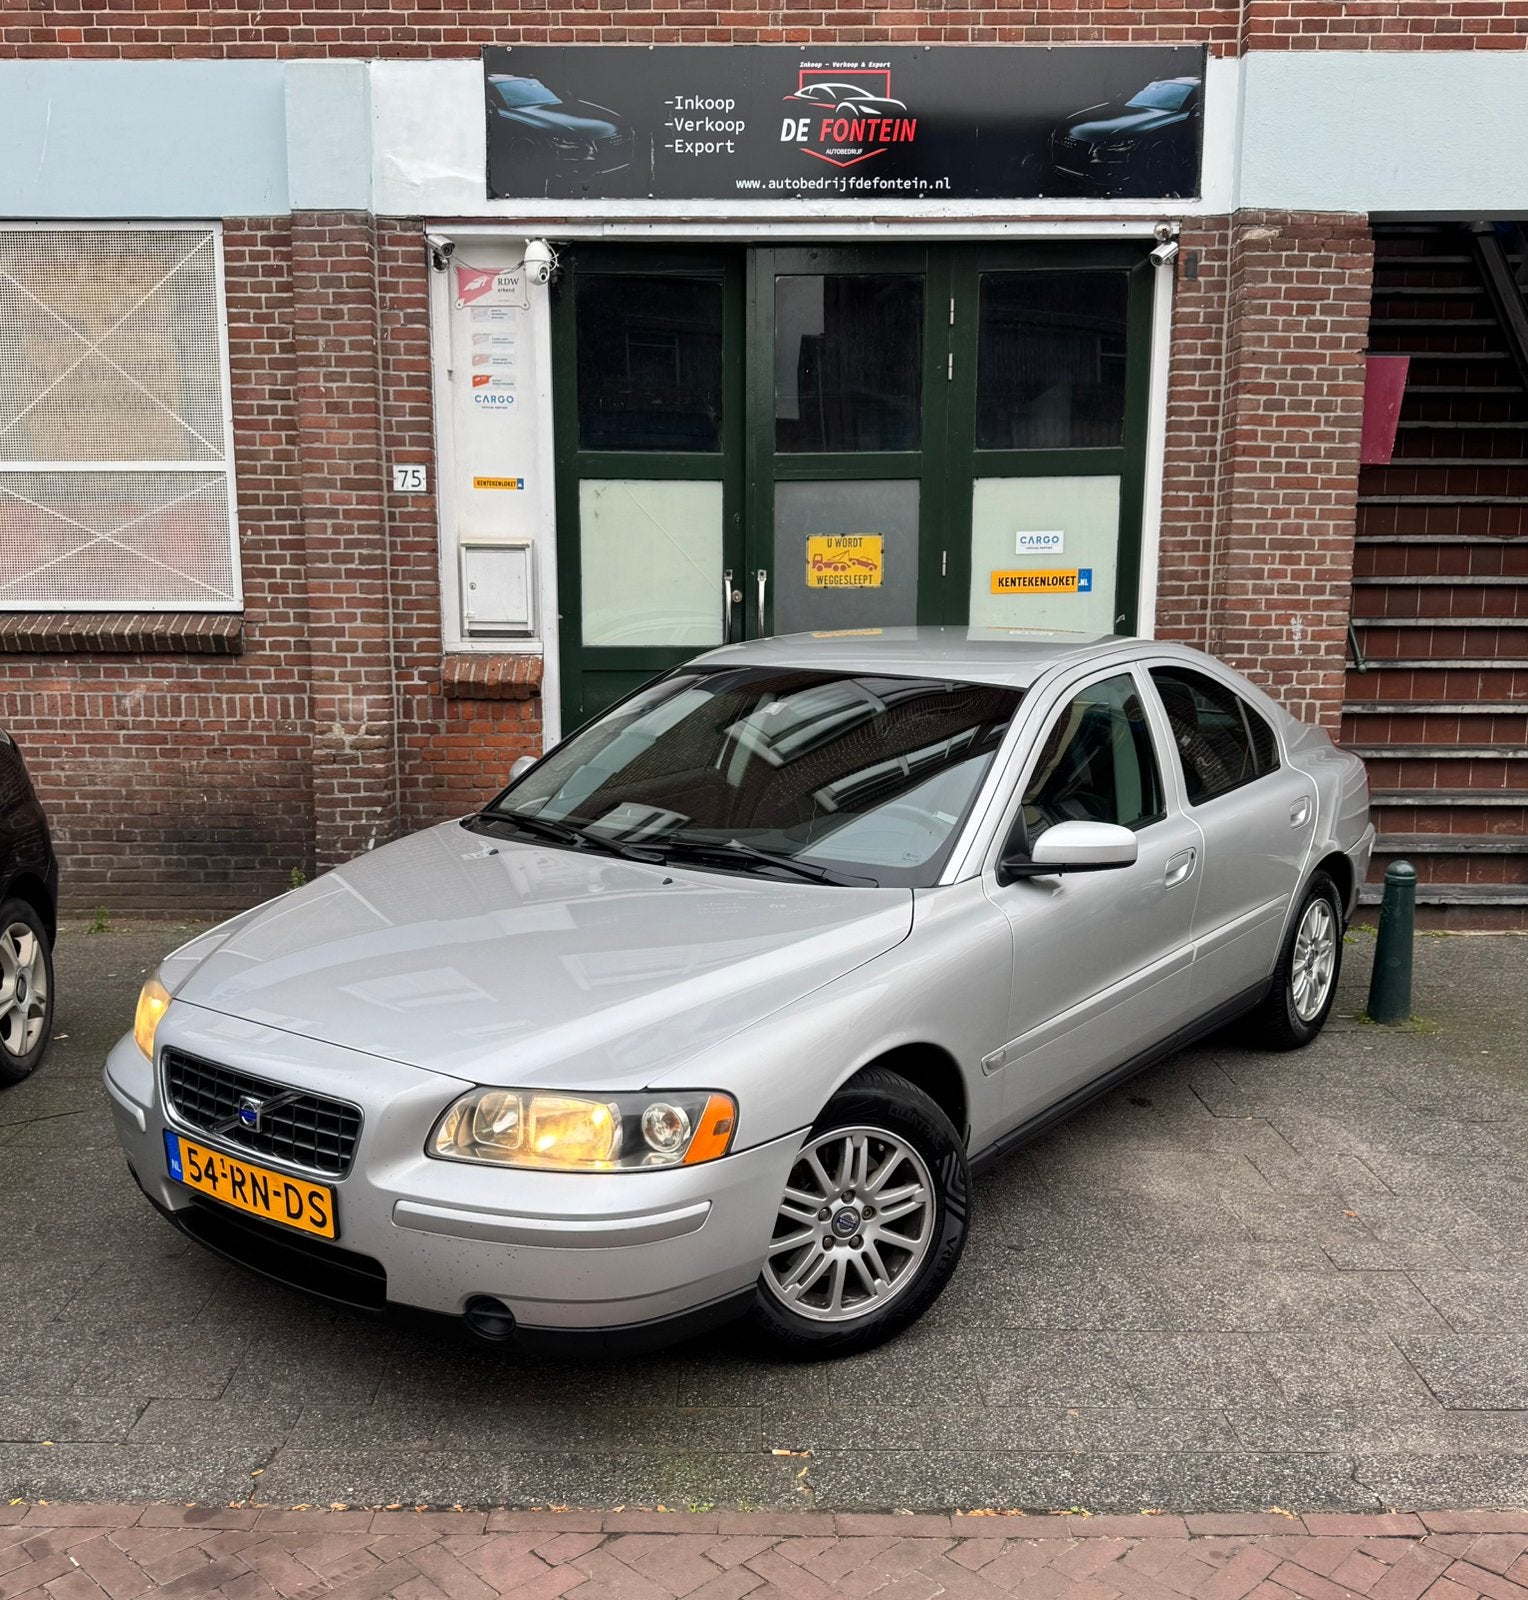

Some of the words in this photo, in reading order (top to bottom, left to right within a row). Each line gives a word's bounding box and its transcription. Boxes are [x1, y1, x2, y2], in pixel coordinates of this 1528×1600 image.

[799, 61, 822, 69] Inkoop
[832, 61, 858, 69] Verkoop
[868, 61, 891, 69] Export
[664, 95, 736, 113] -Inkoop
[664, 117, 745, 135] -Verkoop
[780, 118, 811, 142] DE
[819, 118, 917, 142] FONTEIN
[664, 138, 735, 156] -Export
[736, 176, 951, 192] www.autobedrijfdefontein.nl
[497, 278, 520, 286] RDW
[474, 394, 514, 404] CARGO
[398, 469, 422, 488] 75
[826, 538, 833, 548] U
[834, 537, 864, 548] WORDT
[1019, 535, 1060, 545] CARGO
[816, 574, 874, 586] WEGGESLEEPT
[998, 575, 1076, 587] KENTEKENLOKET
[171, 1158, 182, 1173] NL
[187, 1146, 327, 1228] 54-RN-DS
